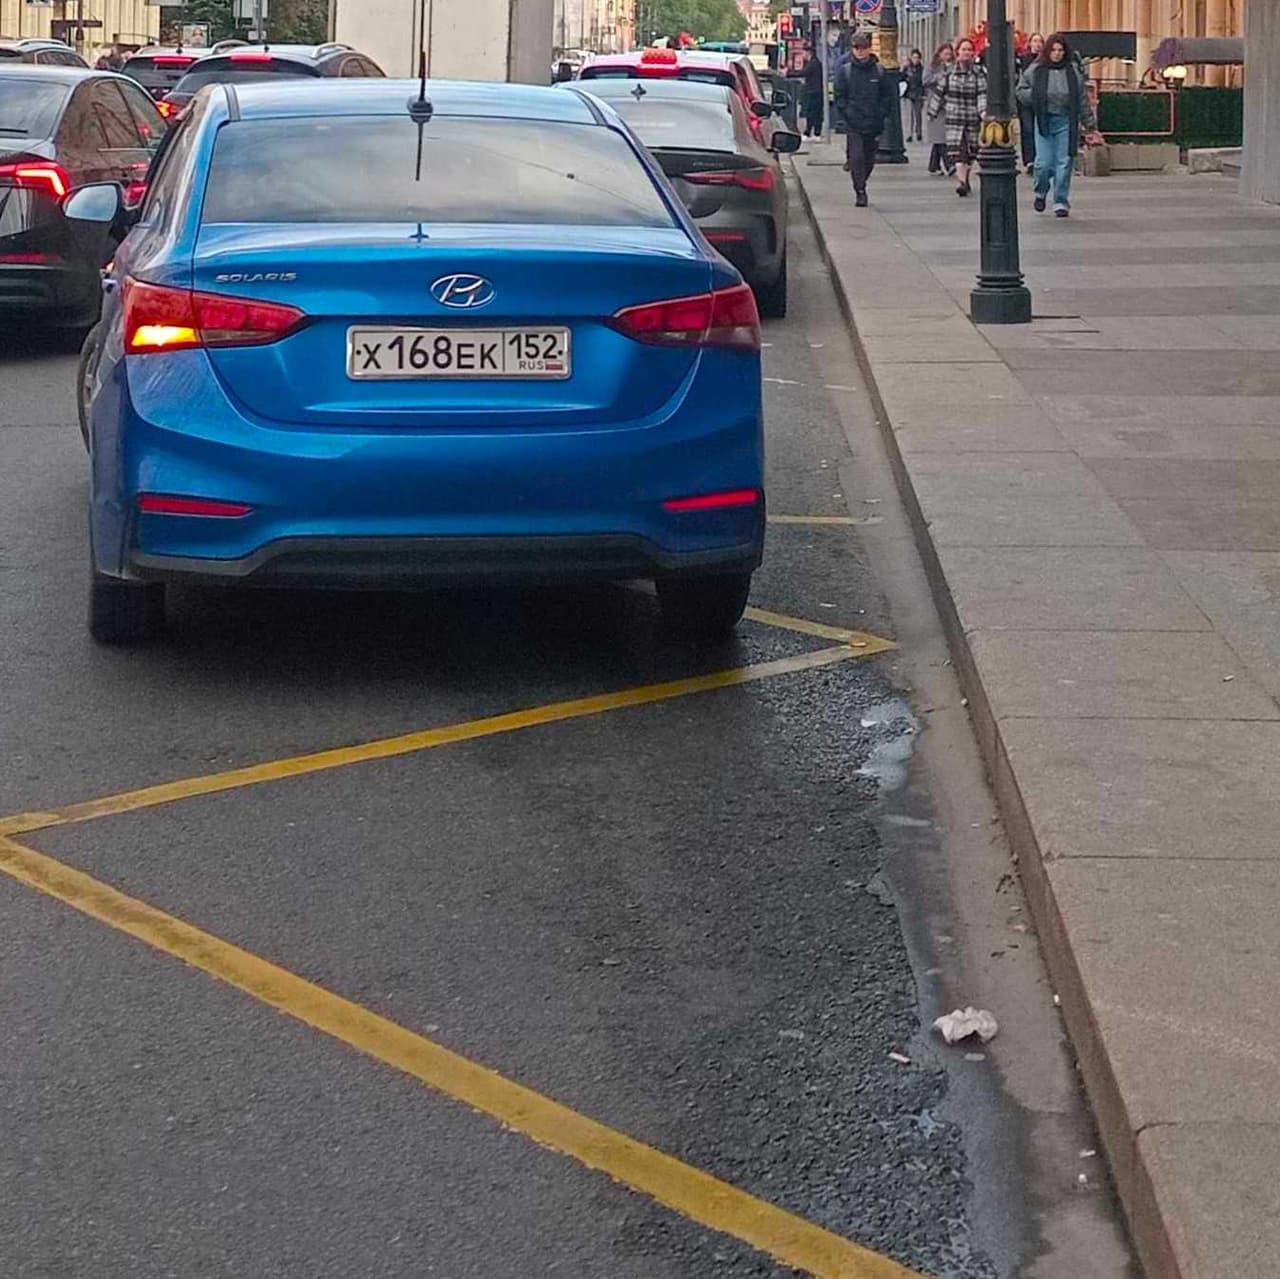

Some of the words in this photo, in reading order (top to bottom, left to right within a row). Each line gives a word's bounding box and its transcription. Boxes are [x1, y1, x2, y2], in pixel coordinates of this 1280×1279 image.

[215, 272, 297, 283] SOLARIS
[361, 334, 498, 370] Х168ЕК
[508, 333, 558, 360] 152
[519, 361, 545, 371] RUS
